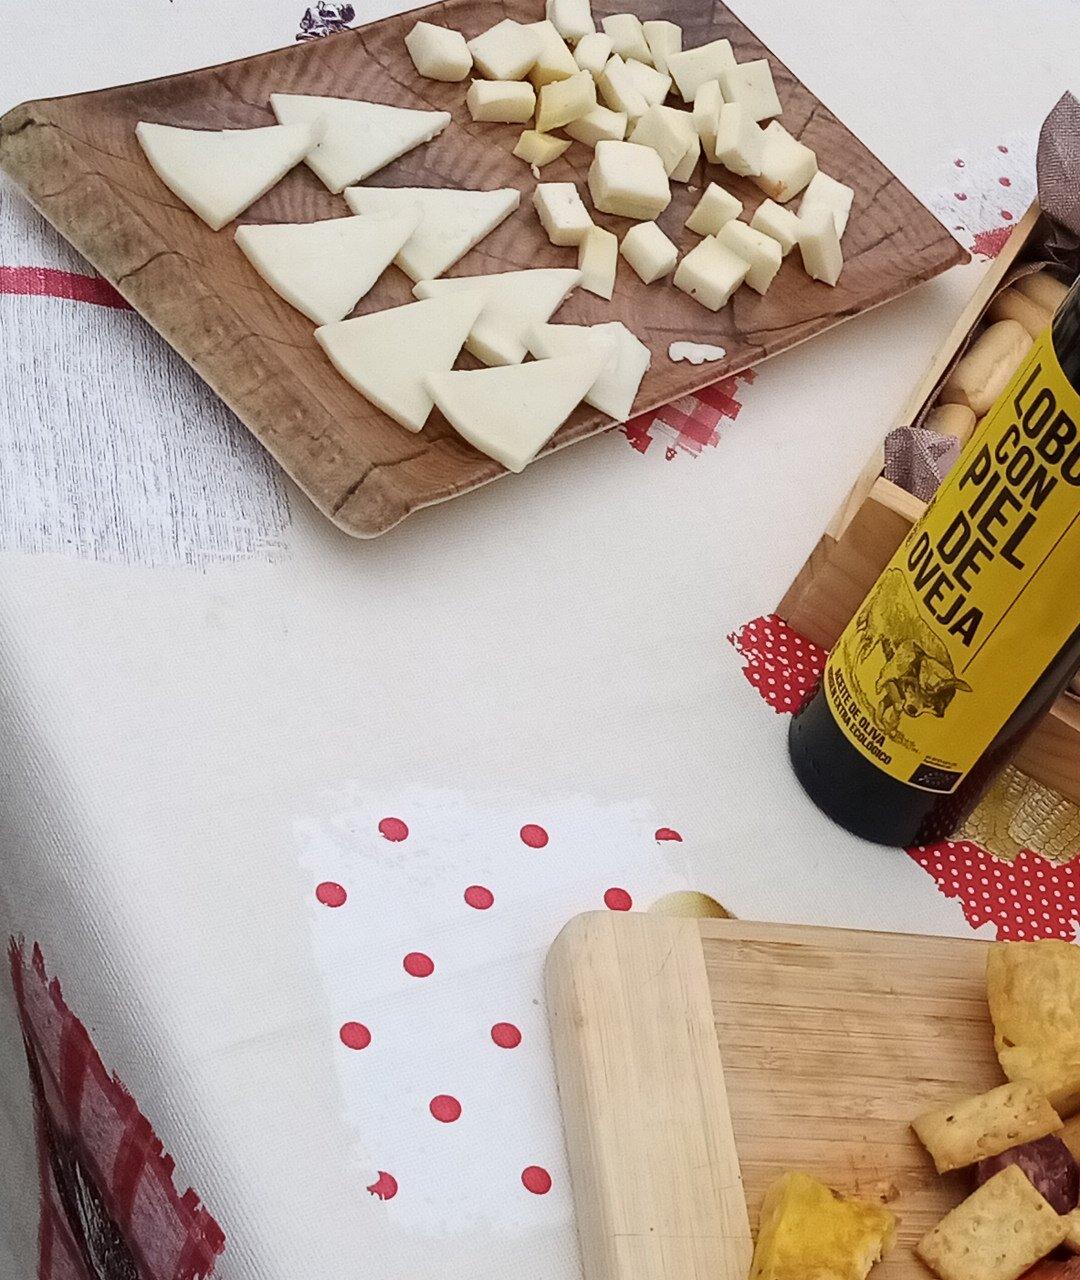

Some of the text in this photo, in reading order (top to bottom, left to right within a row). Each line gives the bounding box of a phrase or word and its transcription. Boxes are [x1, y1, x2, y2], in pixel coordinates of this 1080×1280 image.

[958, 443, 1037, 570] PIEL
[995, 424, 1058, 511] CON
[907, 531, 984, 647] OVEJA
[936, 510, 995, 593] DE
[834, 700, 850, 727] EXTRA
[835, 668, 886, 748] ACEITE DE OLIVA
